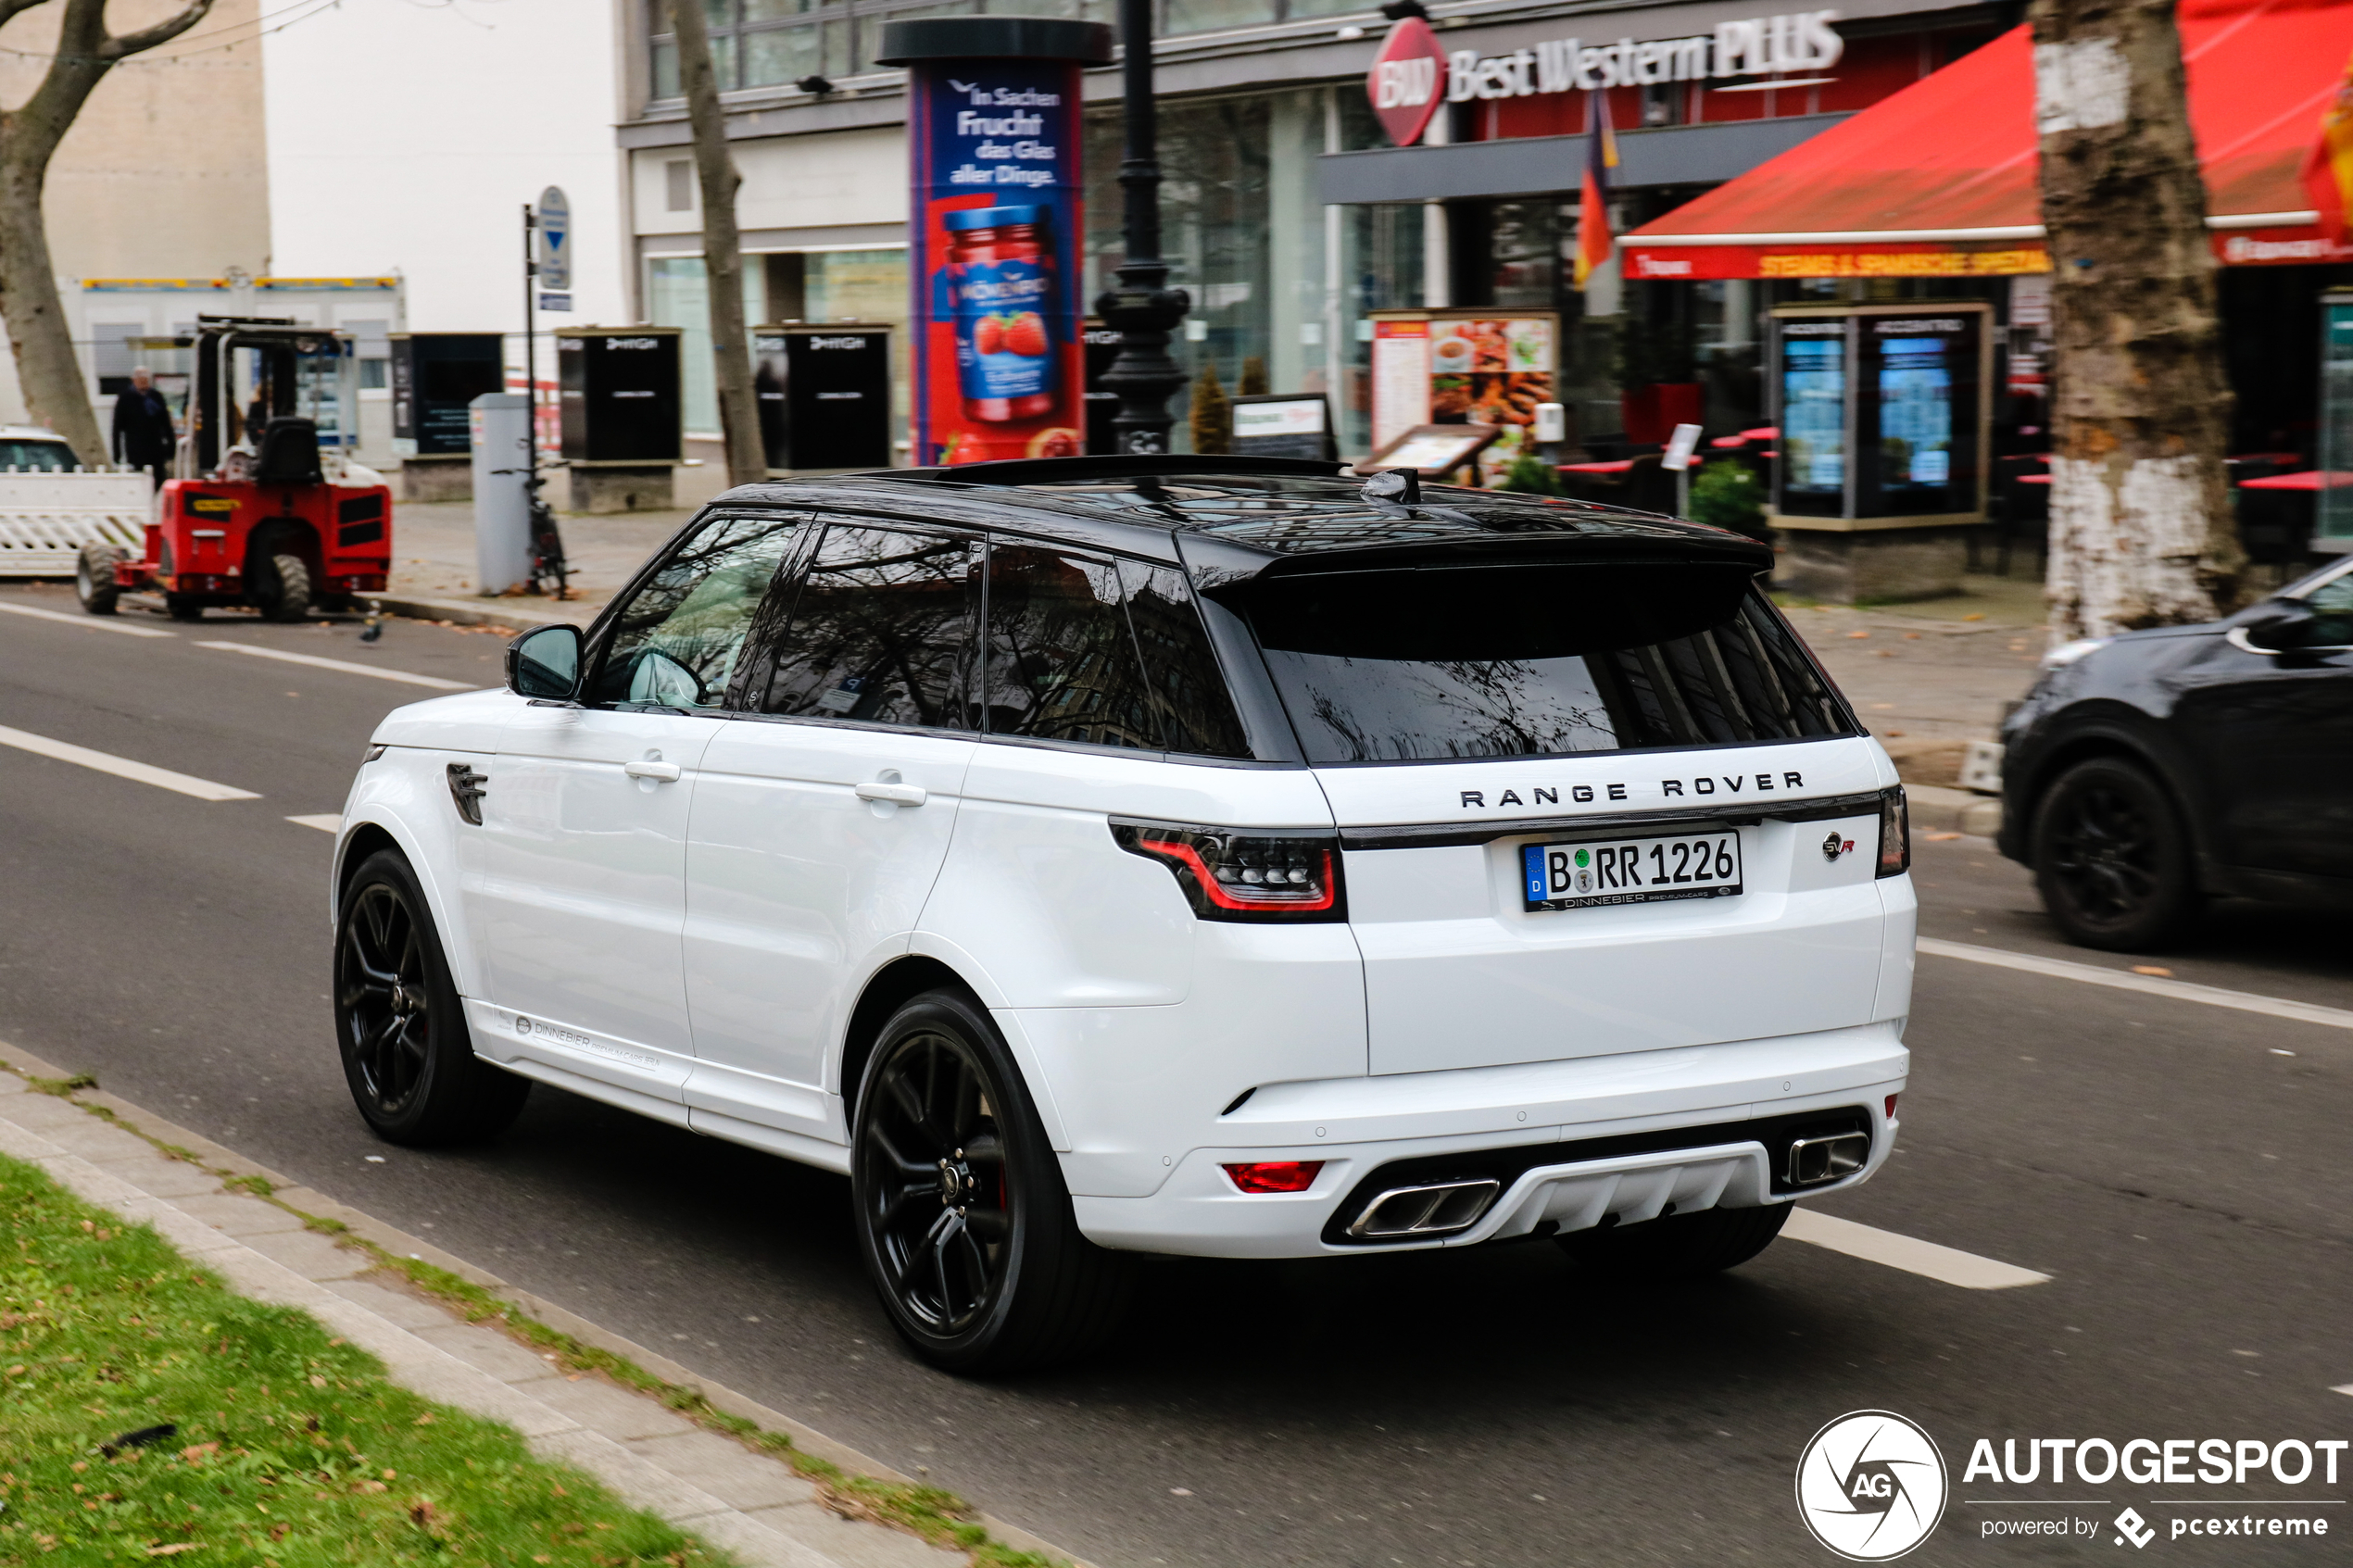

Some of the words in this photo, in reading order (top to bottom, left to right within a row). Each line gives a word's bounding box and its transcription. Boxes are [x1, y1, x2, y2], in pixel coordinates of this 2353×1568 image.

[1448, 48, 1534, 102] Best
[1536, 35, 1708, 92] Western
[1714, 10, 1844, 78] PLUS
[1376, 56, 1435, 108] BW
[970, 88, 992, 106] In
[993, 87, 1061, 107] Sachen
[957, 109, 1044, 135] Frucht
[975, 139, 1013, 159] das
[1013, 140, 1056, 159] Glas
[950, 164, 993, 183] aller
[994, 165, 1057, 188] Dinge.
[1460, 784, 1628, 808] RANGE
[1662, 771, 1804, 797] ROVER
[1549, 852, 1571, 893] B
[1596, 846, 1642, 889] RR
[1650, 839, 1733, 885] 1226
[1532, 880, 1541, 892] D
[1565, 894, 1644, 908] DINNEBIER
[535, 1023, 590, 1047] DINNEBIER
